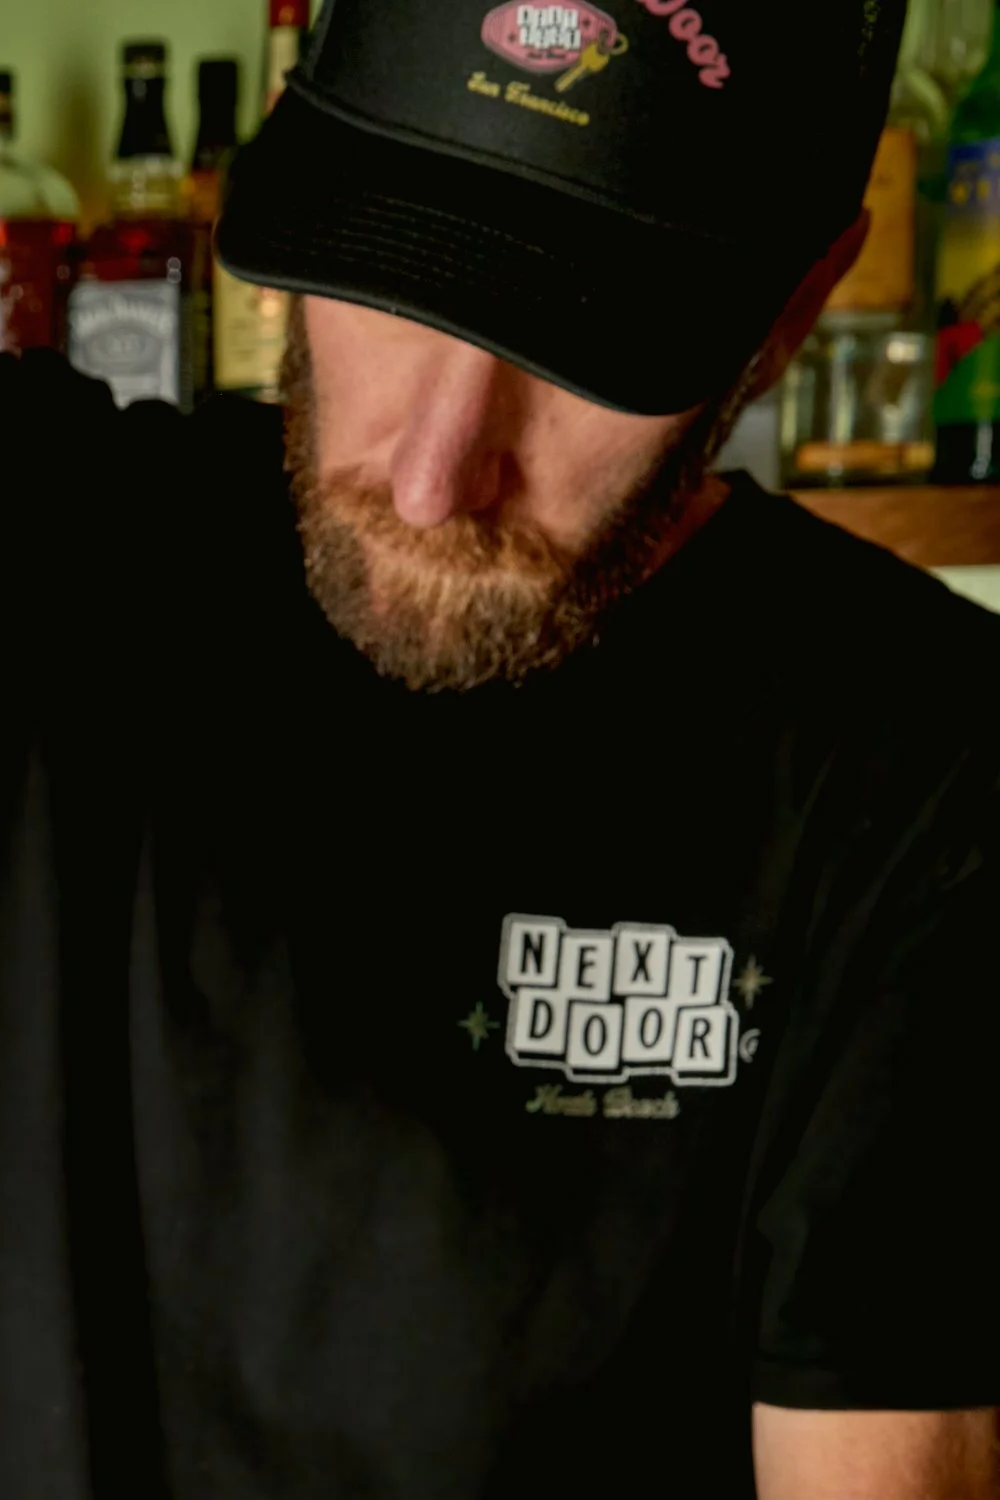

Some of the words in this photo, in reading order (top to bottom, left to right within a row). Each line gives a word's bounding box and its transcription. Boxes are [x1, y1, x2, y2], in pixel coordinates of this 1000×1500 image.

[504, 81, 590, 126] Francisco
[520, 930, 707, 996] NEXT
[529, 997, 712, 1060] DOOR
